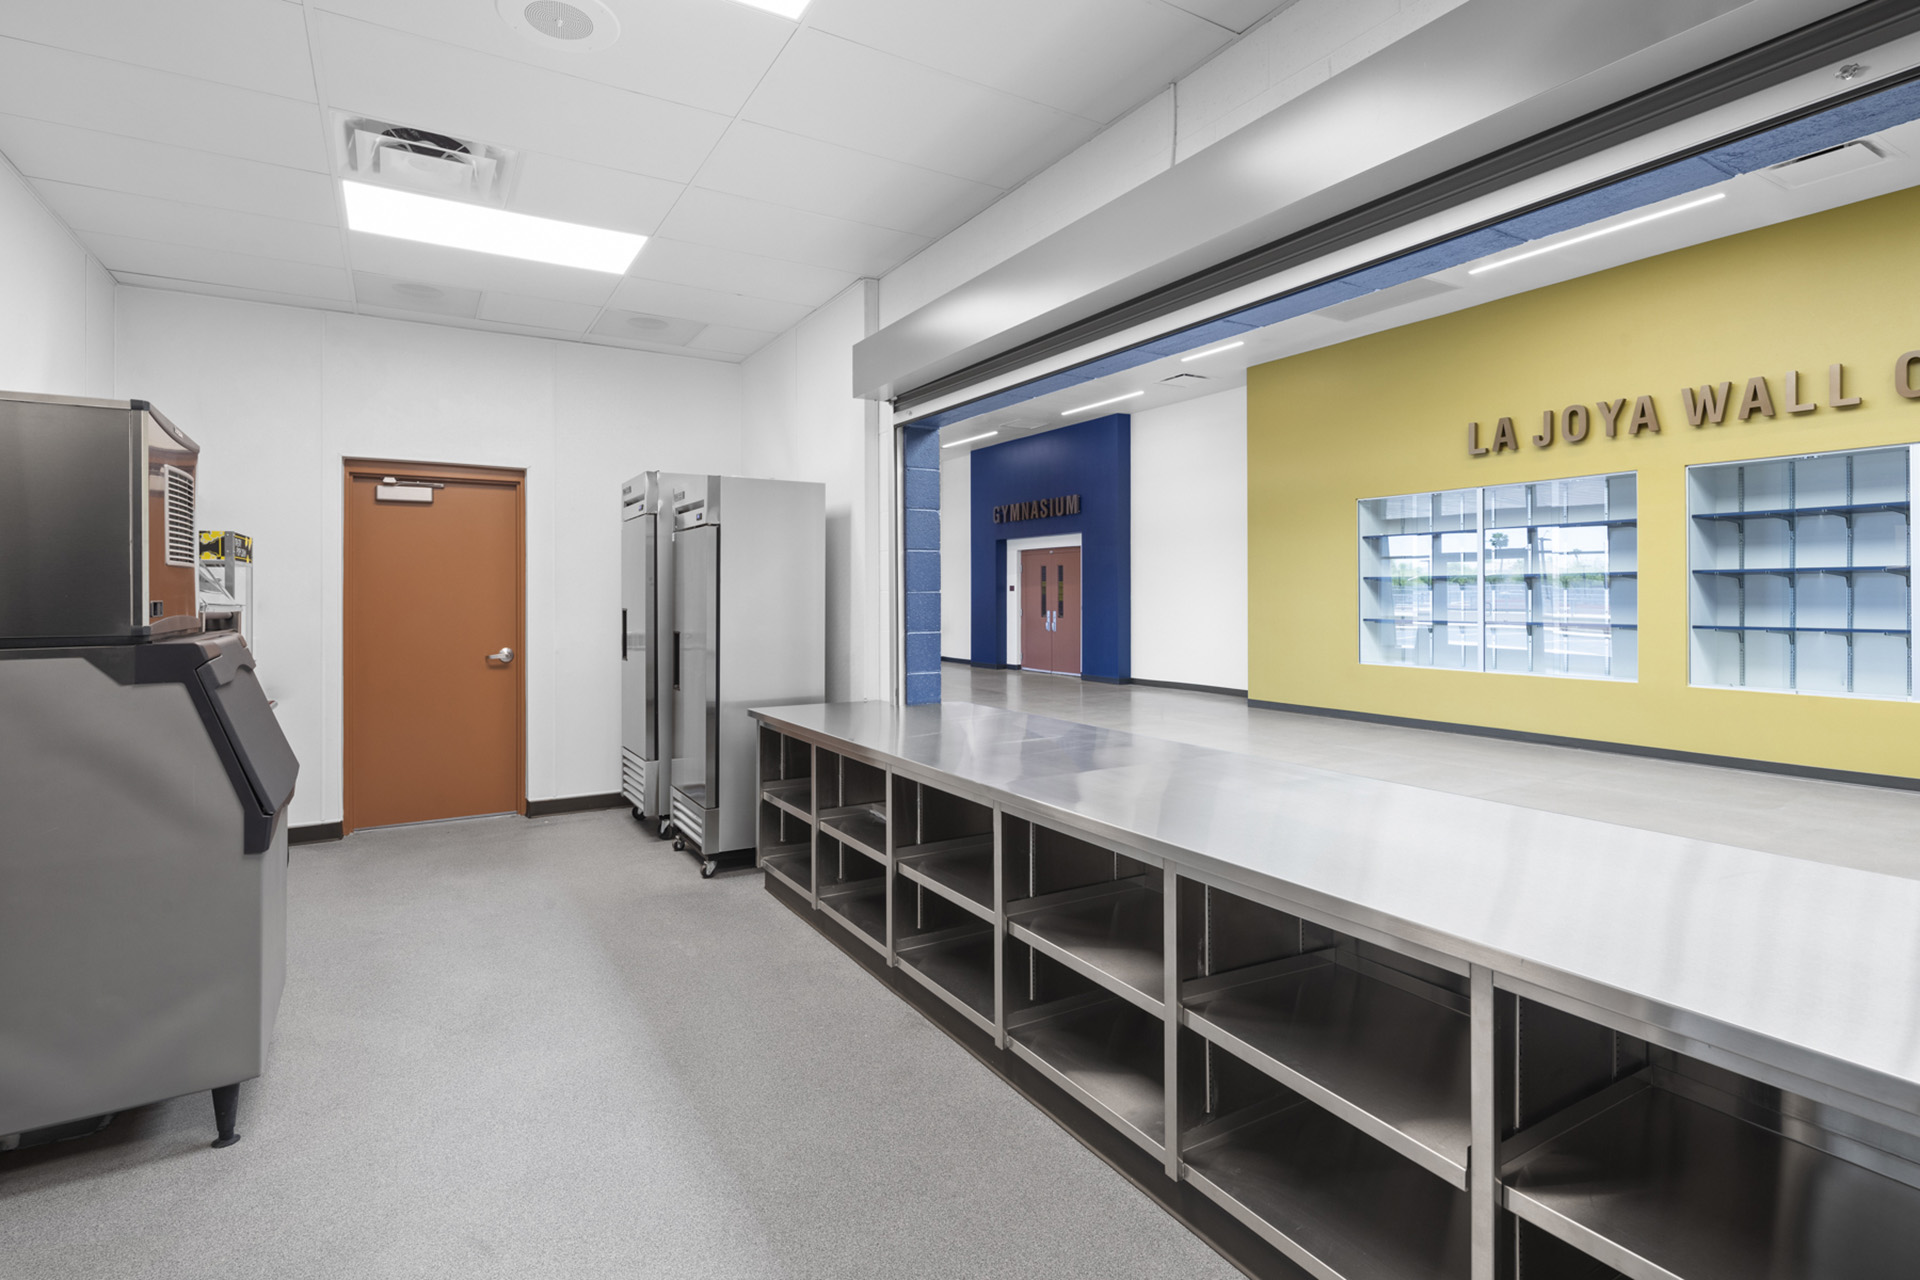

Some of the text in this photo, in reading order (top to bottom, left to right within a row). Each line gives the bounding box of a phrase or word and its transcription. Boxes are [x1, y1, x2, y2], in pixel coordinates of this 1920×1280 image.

[1468, 417, 1519, 456] LA
[1532, 394, 1660, 449] JOYA
[1681, 363, 1863, 428] WALL
[993, 494, 1081, 524] GYMNASIUM
